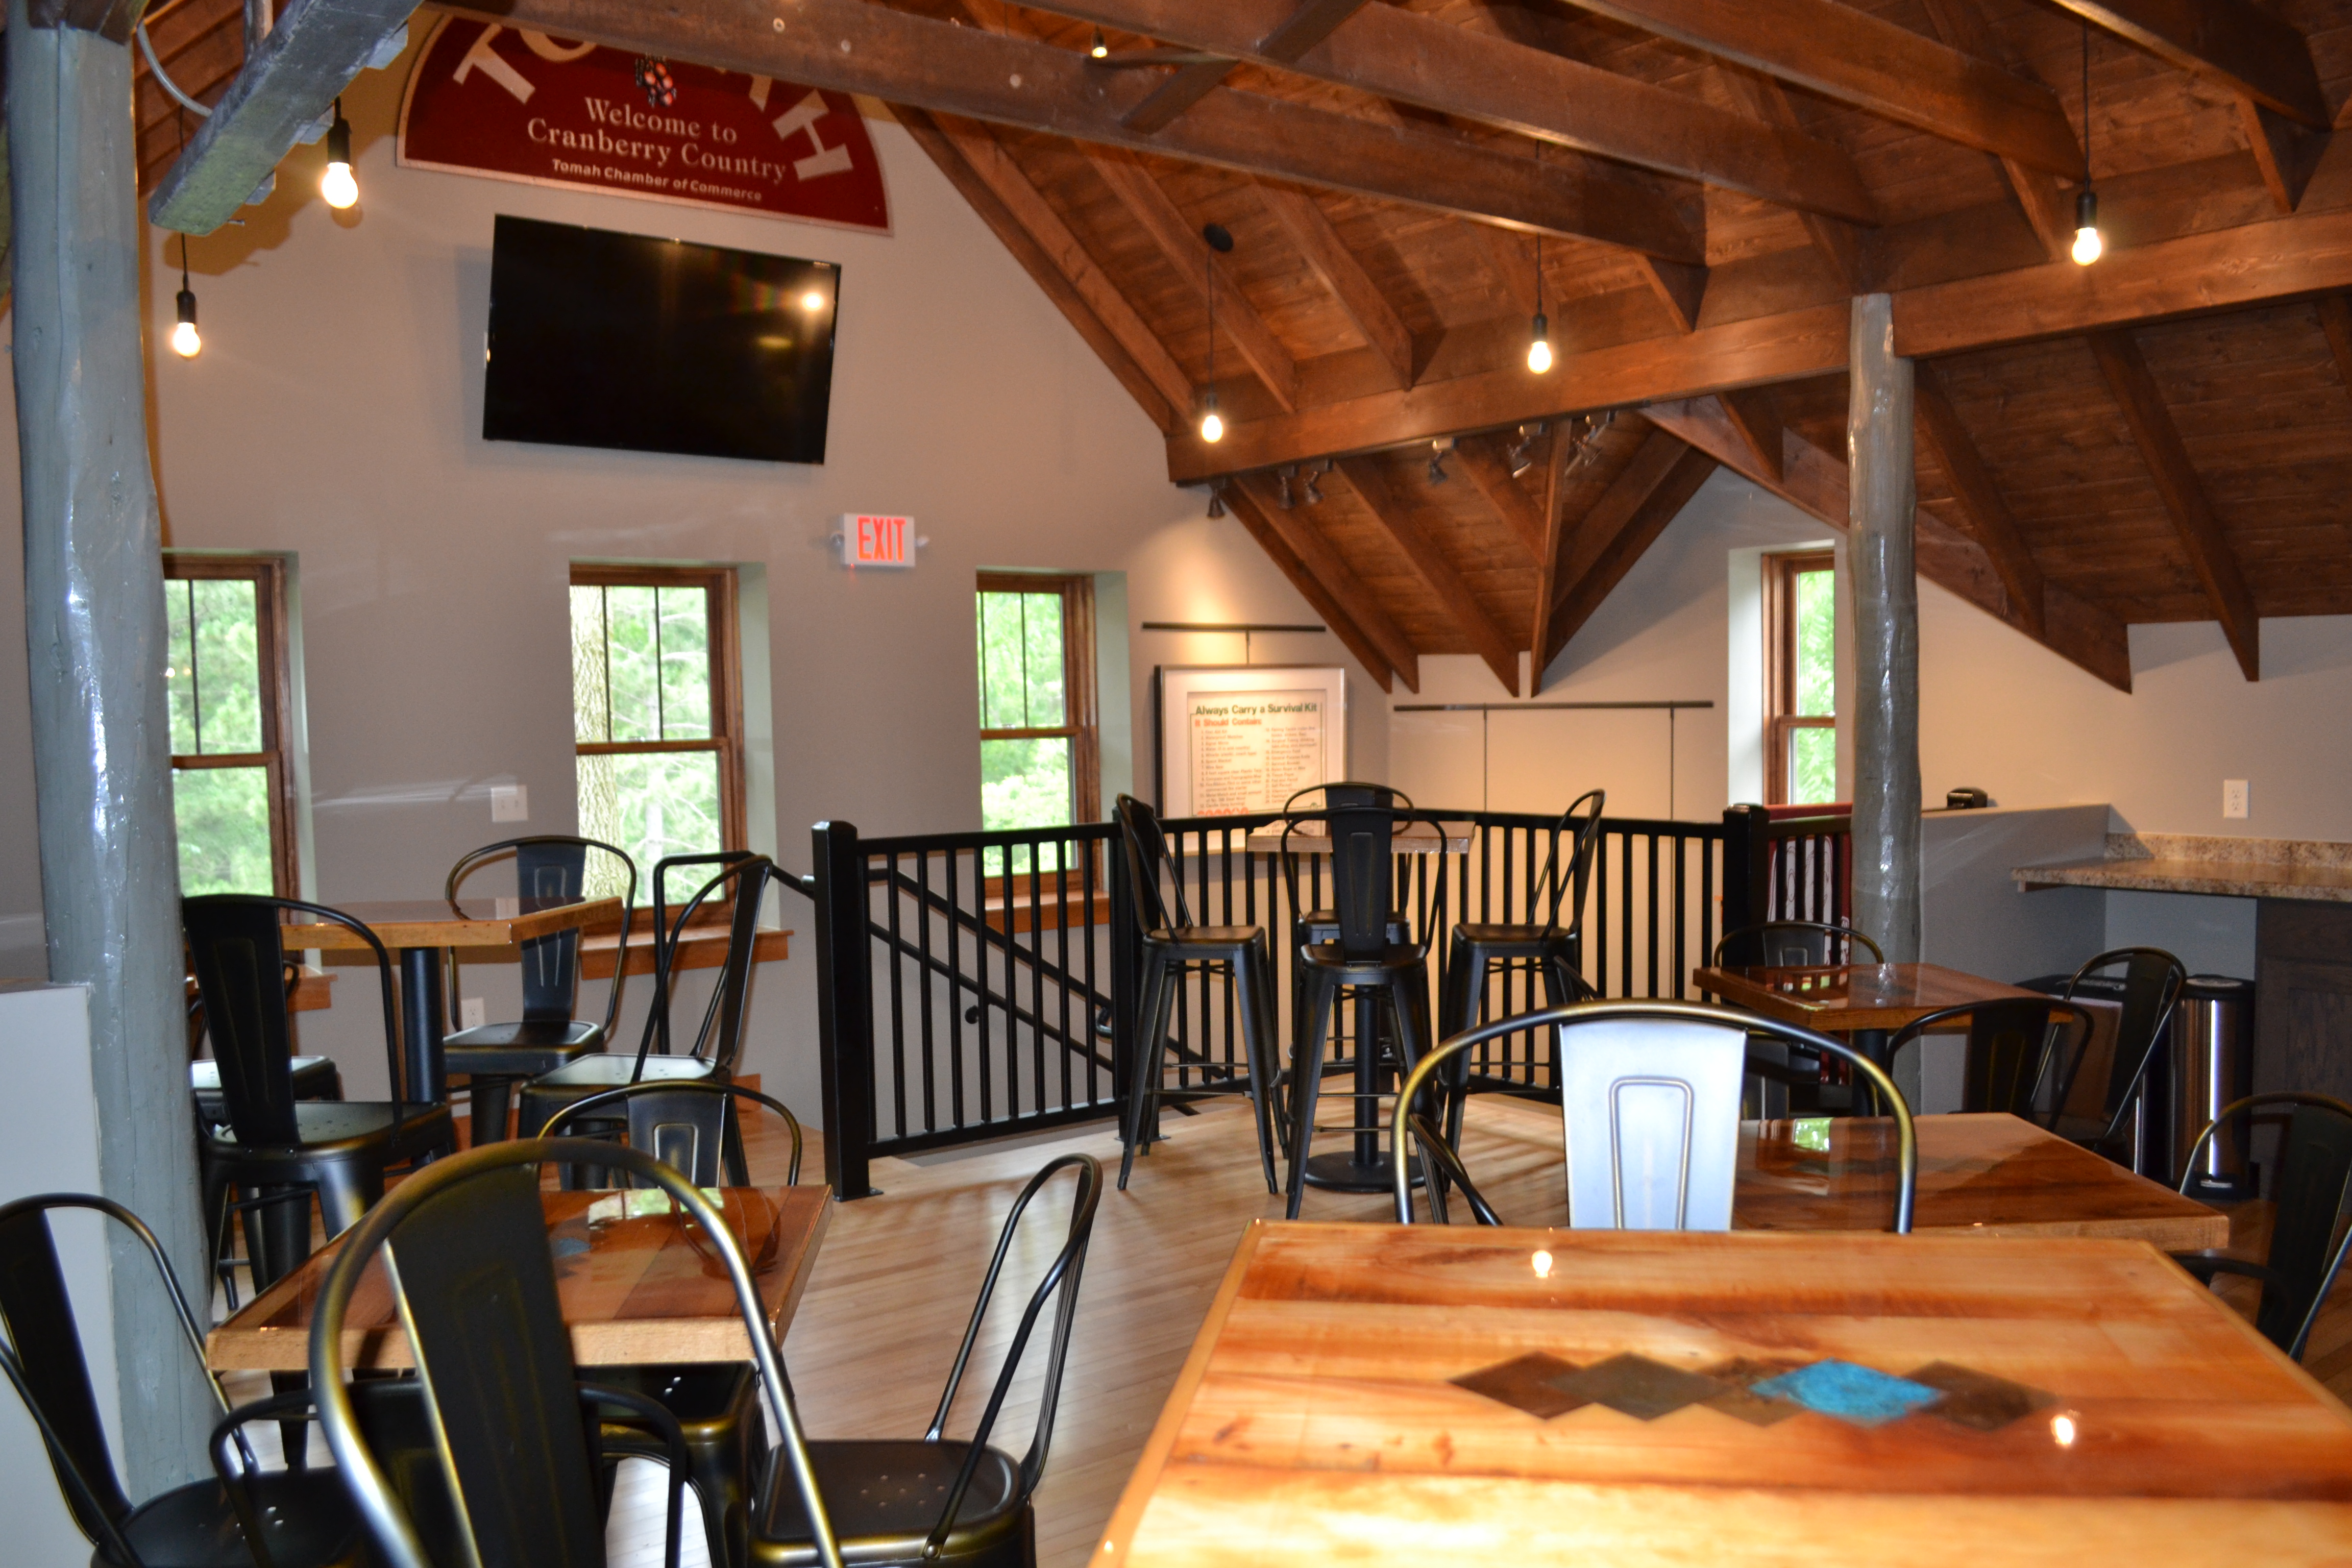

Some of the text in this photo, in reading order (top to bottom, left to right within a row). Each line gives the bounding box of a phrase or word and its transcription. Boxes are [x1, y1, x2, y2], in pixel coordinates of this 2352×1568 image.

[585, 97, 737, 145] Welcome to
[528, 117, 787, 186] Cranberry Country
[553, 159, 762, 202] Tomah Chamber of Commerce
[857, 516, 906, 562] EXIT
[1195, 705, 1229, 716] Always
[1232, 704, 1257, 715] Carry
[1267, 703, 1303, 713] Survival
[1305, 702, 1317, 712] Kit
[1195, 717, 1262, 727] It Should Contain:
